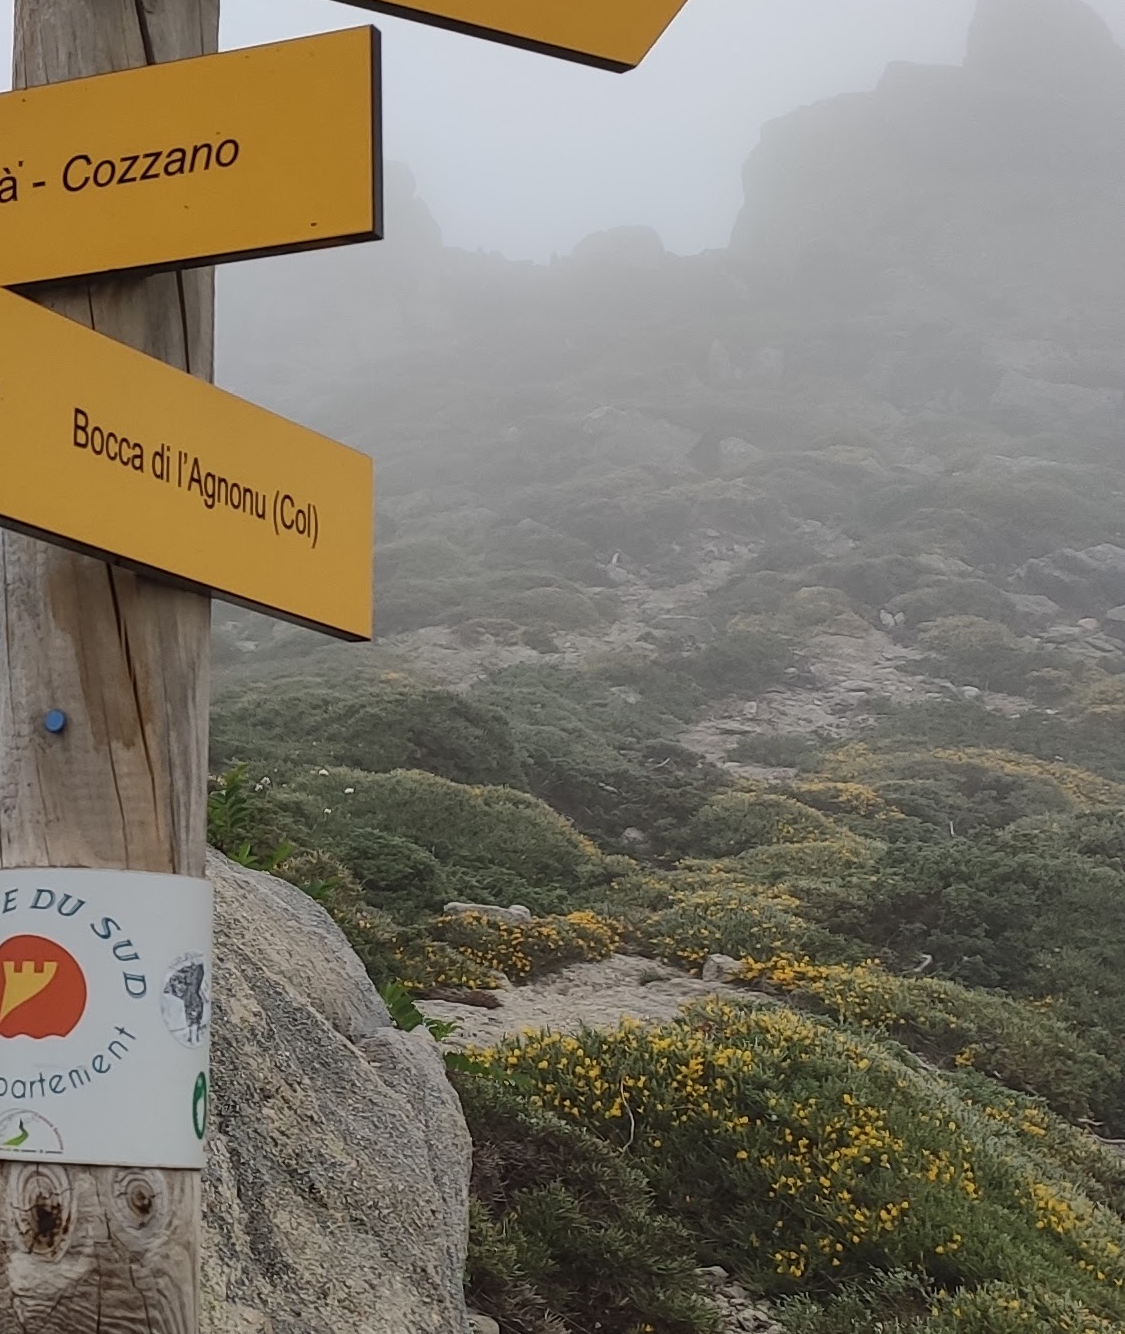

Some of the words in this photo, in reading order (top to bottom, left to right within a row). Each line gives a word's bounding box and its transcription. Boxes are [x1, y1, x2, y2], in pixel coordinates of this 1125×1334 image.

[31, 179, 47, 190] -
[62, 138, 241, 193] Cozzano
[73, 407, 146, 475] Bocca
[151, 442, 172, 483] di
[272, 492, 320, 549] (Col)
[29, 888, 86, 917] DU
[90, 917, 148, 999] SUD
